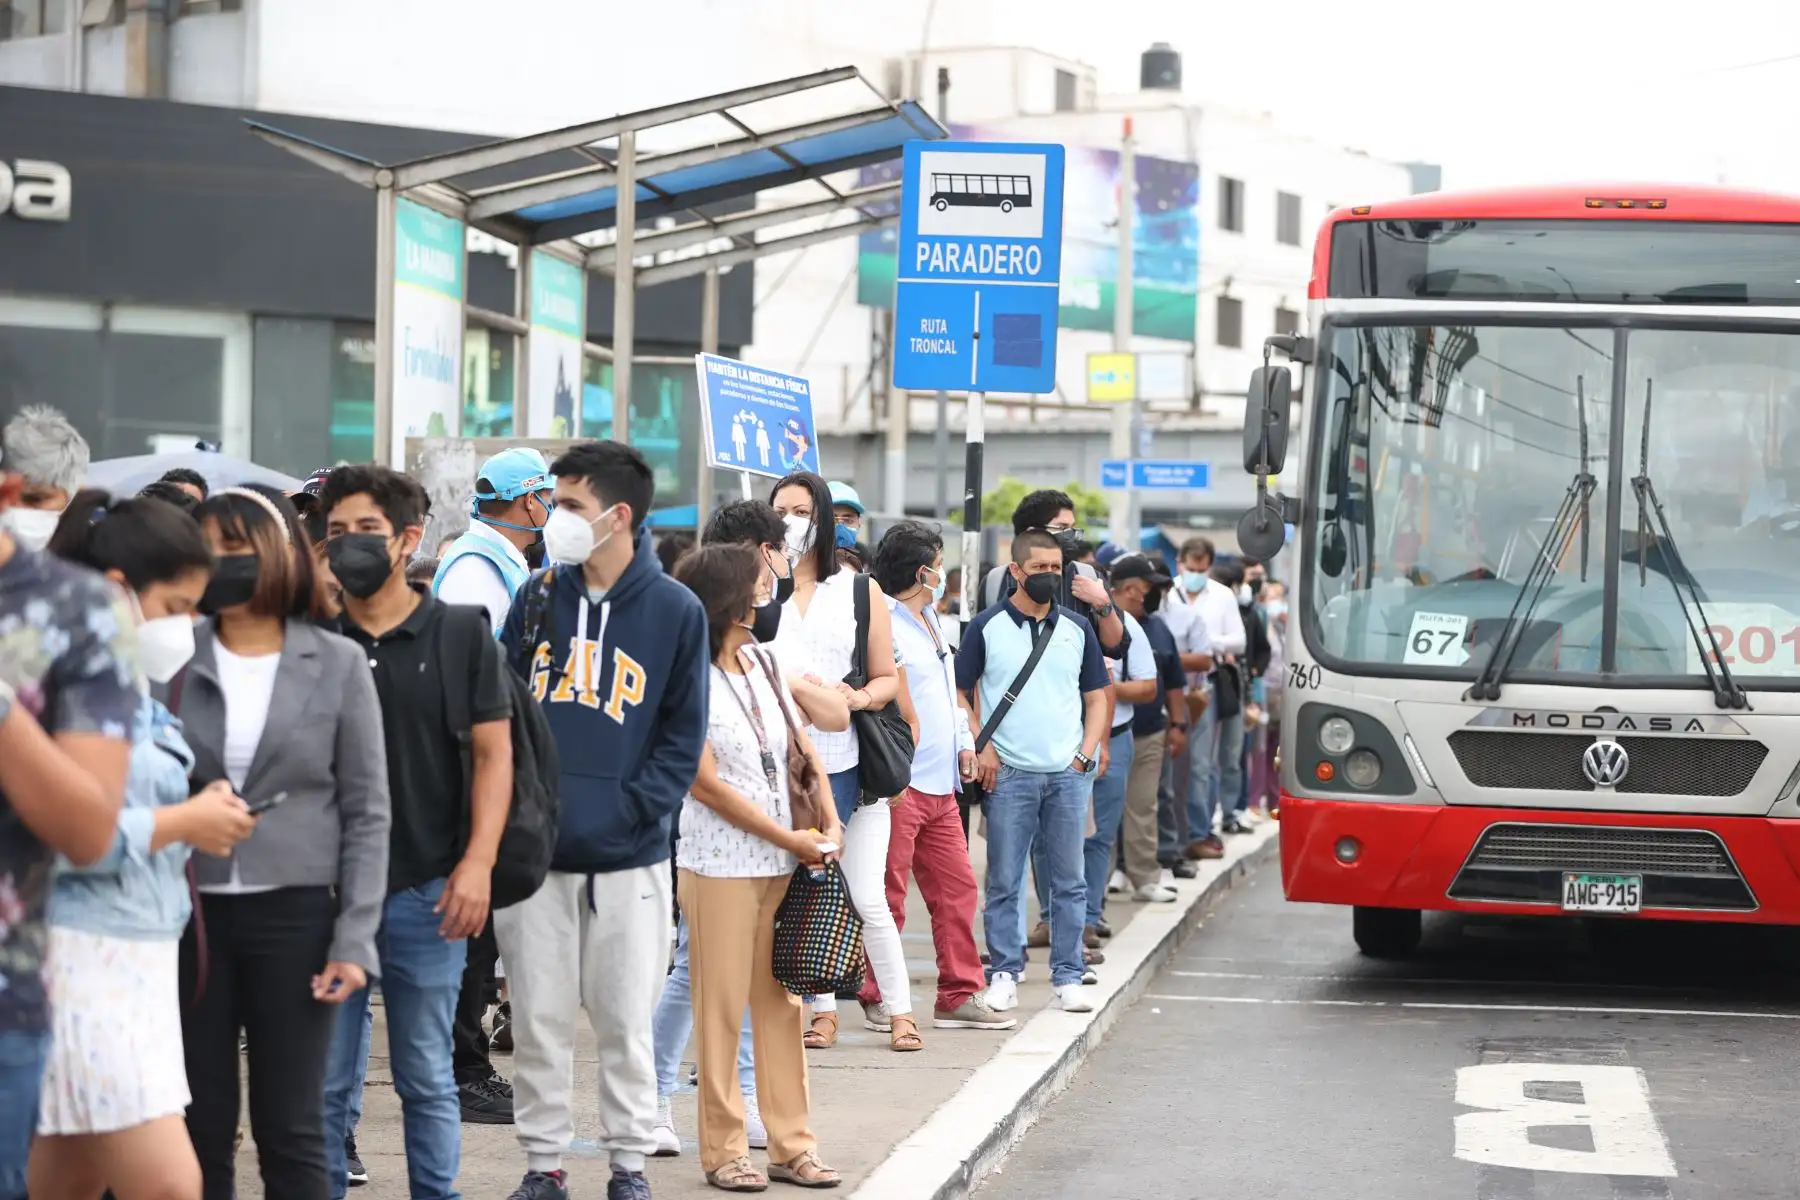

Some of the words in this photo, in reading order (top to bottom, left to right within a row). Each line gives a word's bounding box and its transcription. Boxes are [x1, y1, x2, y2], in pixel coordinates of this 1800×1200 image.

[916, 241, 1042, 276] PARADERO
[920, 318, 948, 334] RUTA
[910, 337, 957, 355] TRONCAL
[738, 367, 749, 380] LA
[749, 371, 786, 389] DISTANCIA
[786, 377, 809, 396] FÍSICA
[1418, 614, 1444, 623] RUTA
[1412, 629, 1459, 656] 67
[1701, 625, 1800, 666] 201
[528, 636, 647, 725] GAP
[1288, 662, 1321, 690] 760
[1513, 712, 1705, 732] MODASA
[1566, 883, 1638, 906] AWG-915
